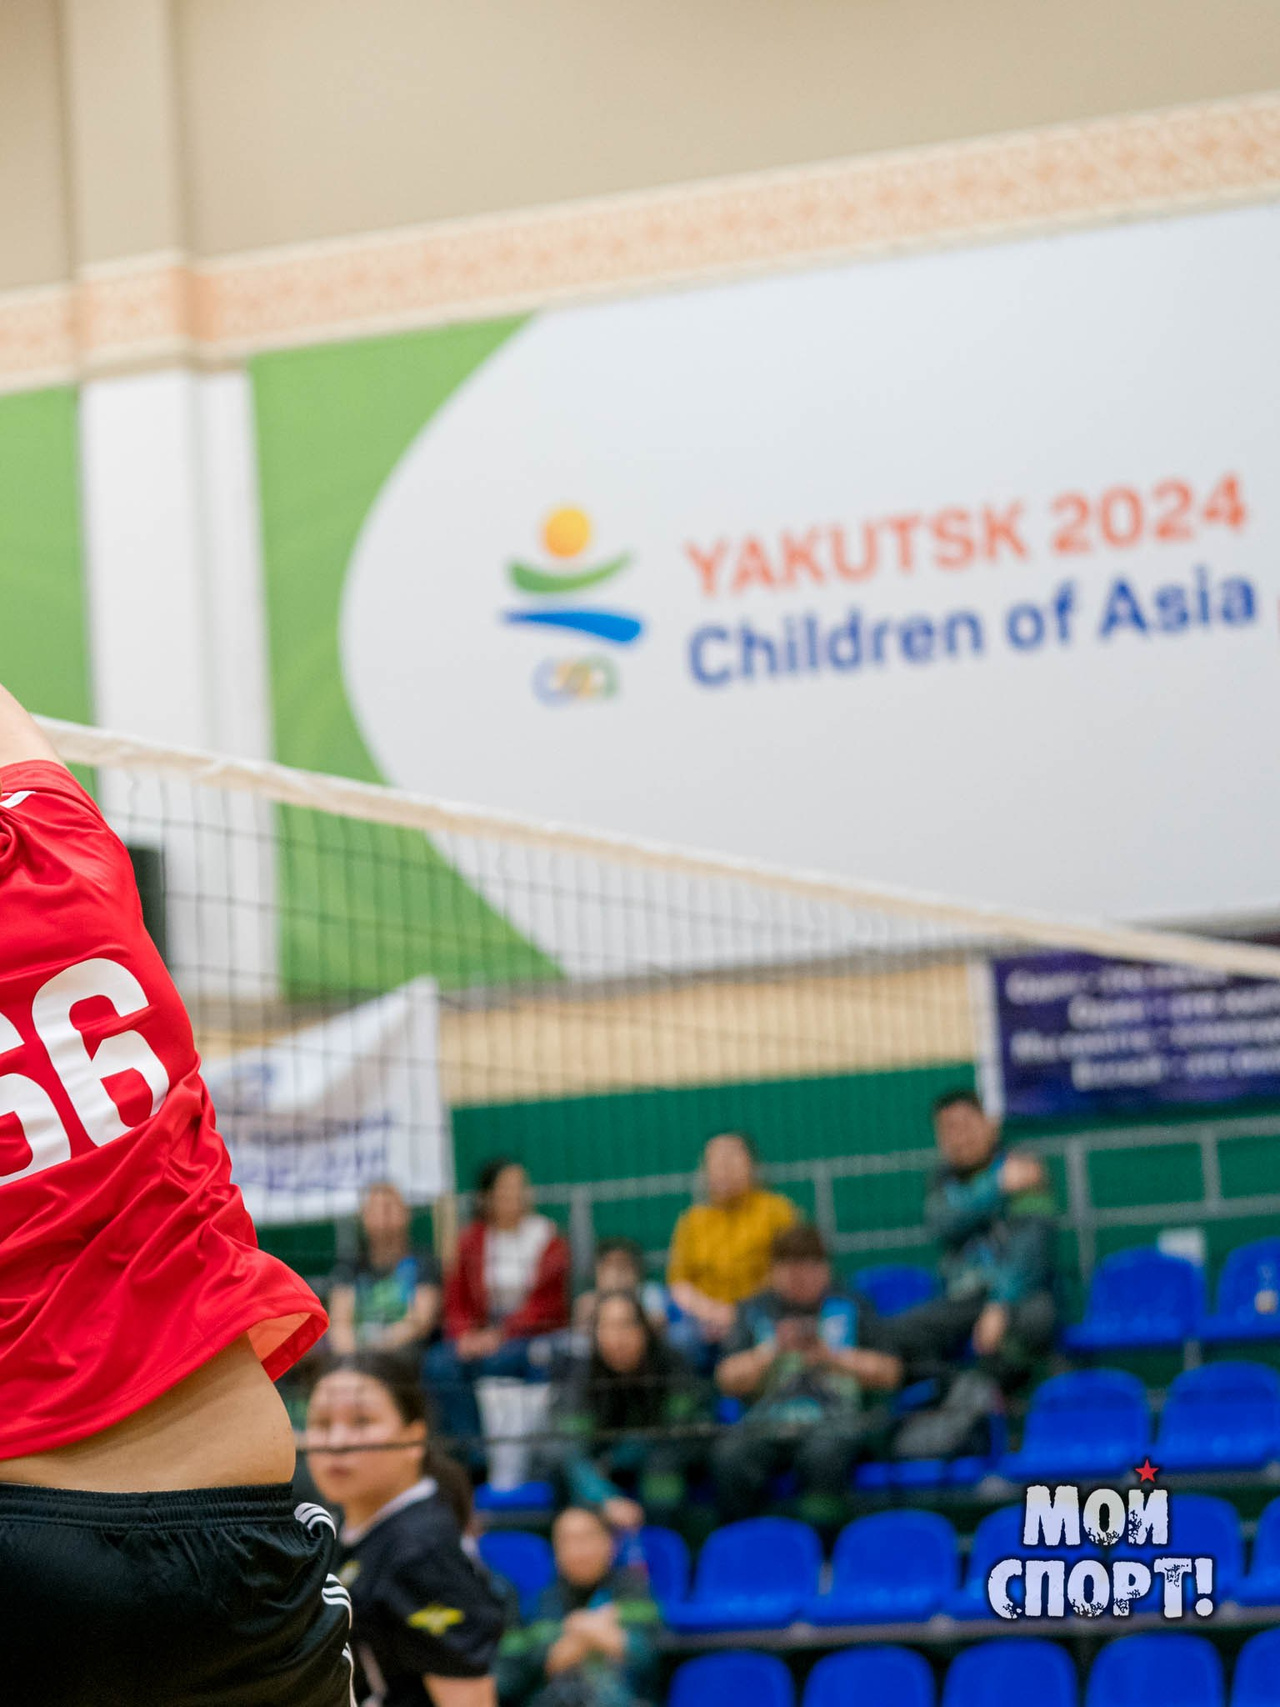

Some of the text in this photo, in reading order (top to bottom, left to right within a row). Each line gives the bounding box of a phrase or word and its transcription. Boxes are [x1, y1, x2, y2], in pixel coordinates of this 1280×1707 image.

[685, 470, 1250, 599] YAKUTSK 2024
[686, 602, 984, 688] Children
[1004, 576, 1077, 653] of
[1096, 562, 1258, 641] Asia
